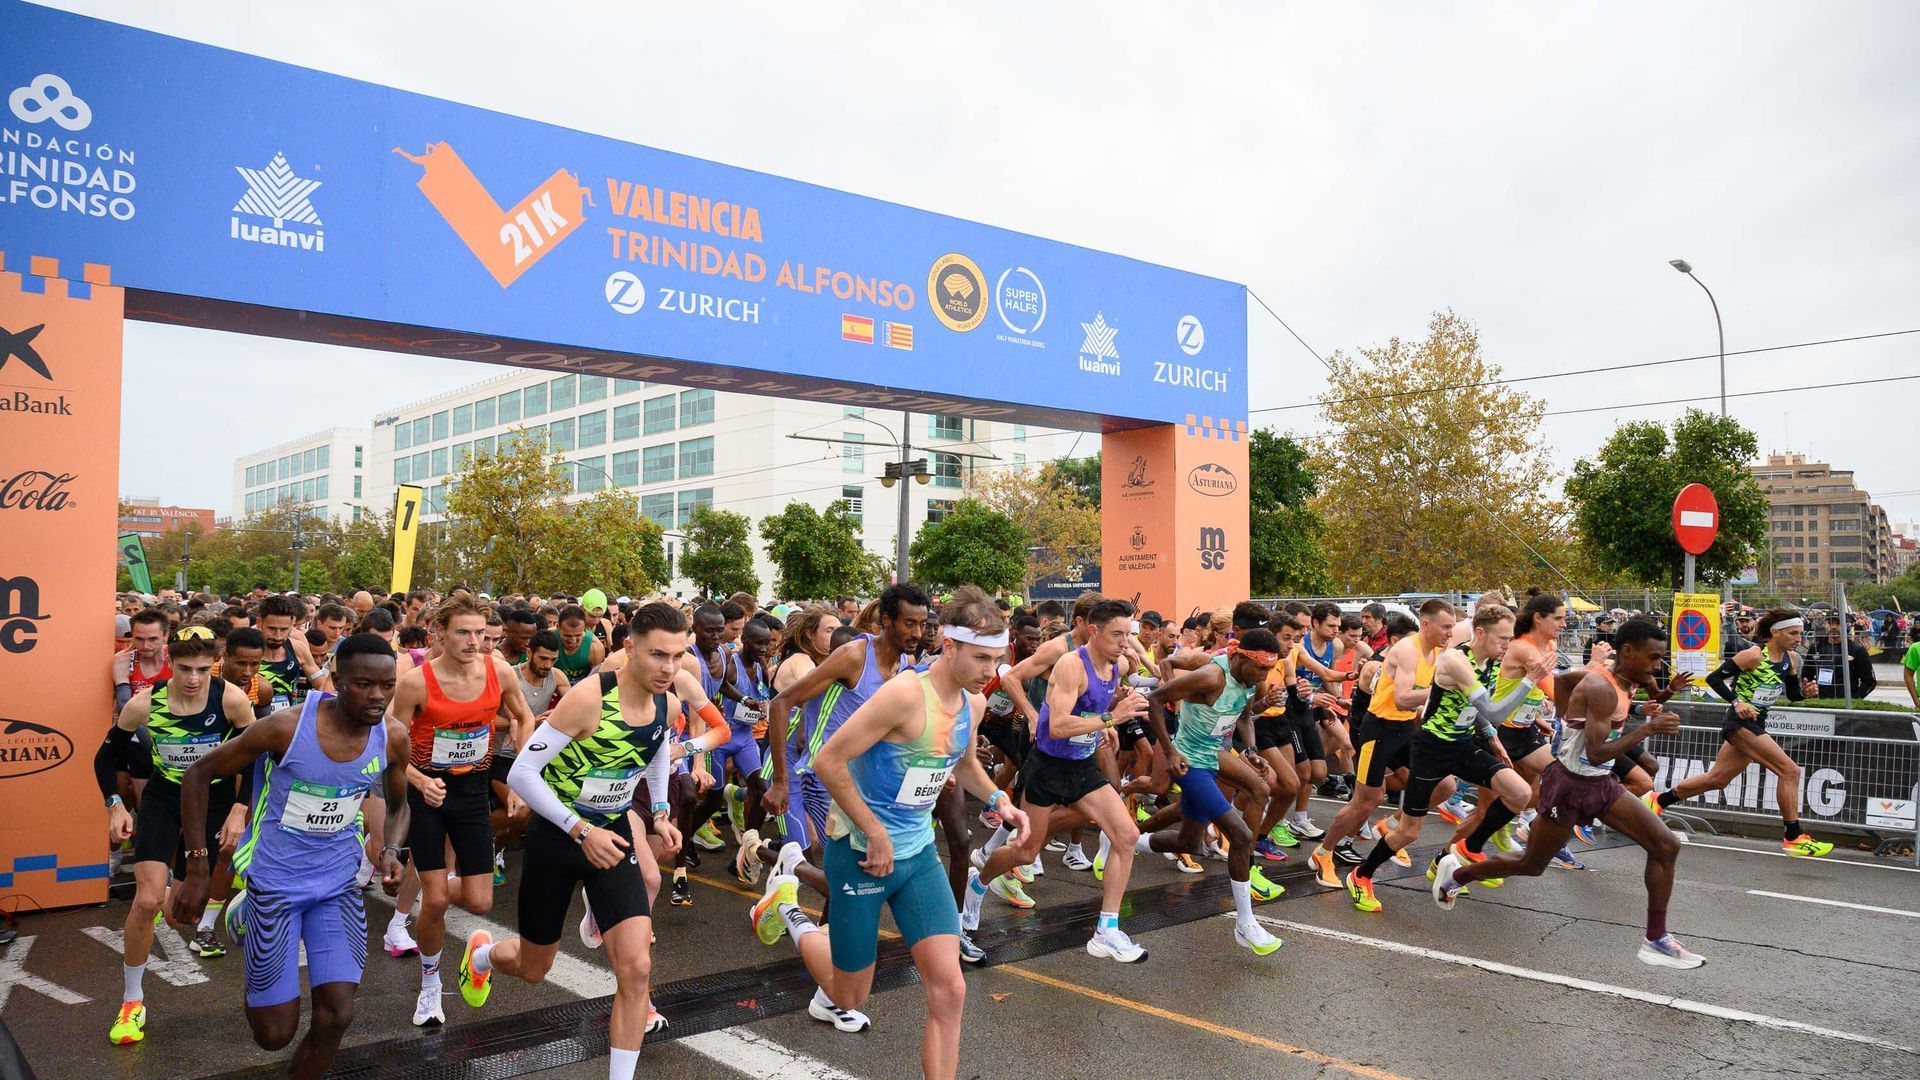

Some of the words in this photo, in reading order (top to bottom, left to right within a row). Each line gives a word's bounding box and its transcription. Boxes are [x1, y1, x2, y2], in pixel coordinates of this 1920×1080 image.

[0, 151, 137, 194] INIDAD
[0, 180, 136, 221] FONSO
[606, 178, 763, 243] VALENCIA
[230, 217, 324, 252] luanvi
[500, 190, 568, 266] 21K
[606, 227, 767, 283] TRINIDAD
[775, 260, 915, 311] ALFONSO
[1005, 287, 1038, 303] SUPER
[657, 287, 760, 324] ZURICH
[945, 304, 972, 314] ATHLETICS
[949, 299, 968, 308] WORLD
[1005, 299, 1038, 314] HALFS
[1079, 355, 1120, 376] luanvi
[1153, 361, 1227, 393] ZURICH
[1192, 473, 1234, 490] ASTURIANA
[402, 500, 416, 531] 1
[1119, 553, 1157, 562] AJUNTAMENT
[1780, 722, 1795, 730] DEL
[1796, 723, 1830, 732] RUNNING
[7, 737, 56, 745] LECHERA
[182, 746, 196, 754] 22
[448, 750, 476, 759] PACER
[930, 771, 946, 783] 103
[609, 781, 628, 792] 102
[321, 802, 339, 813] 23
[305, 813, 344, 825] KITIYO
